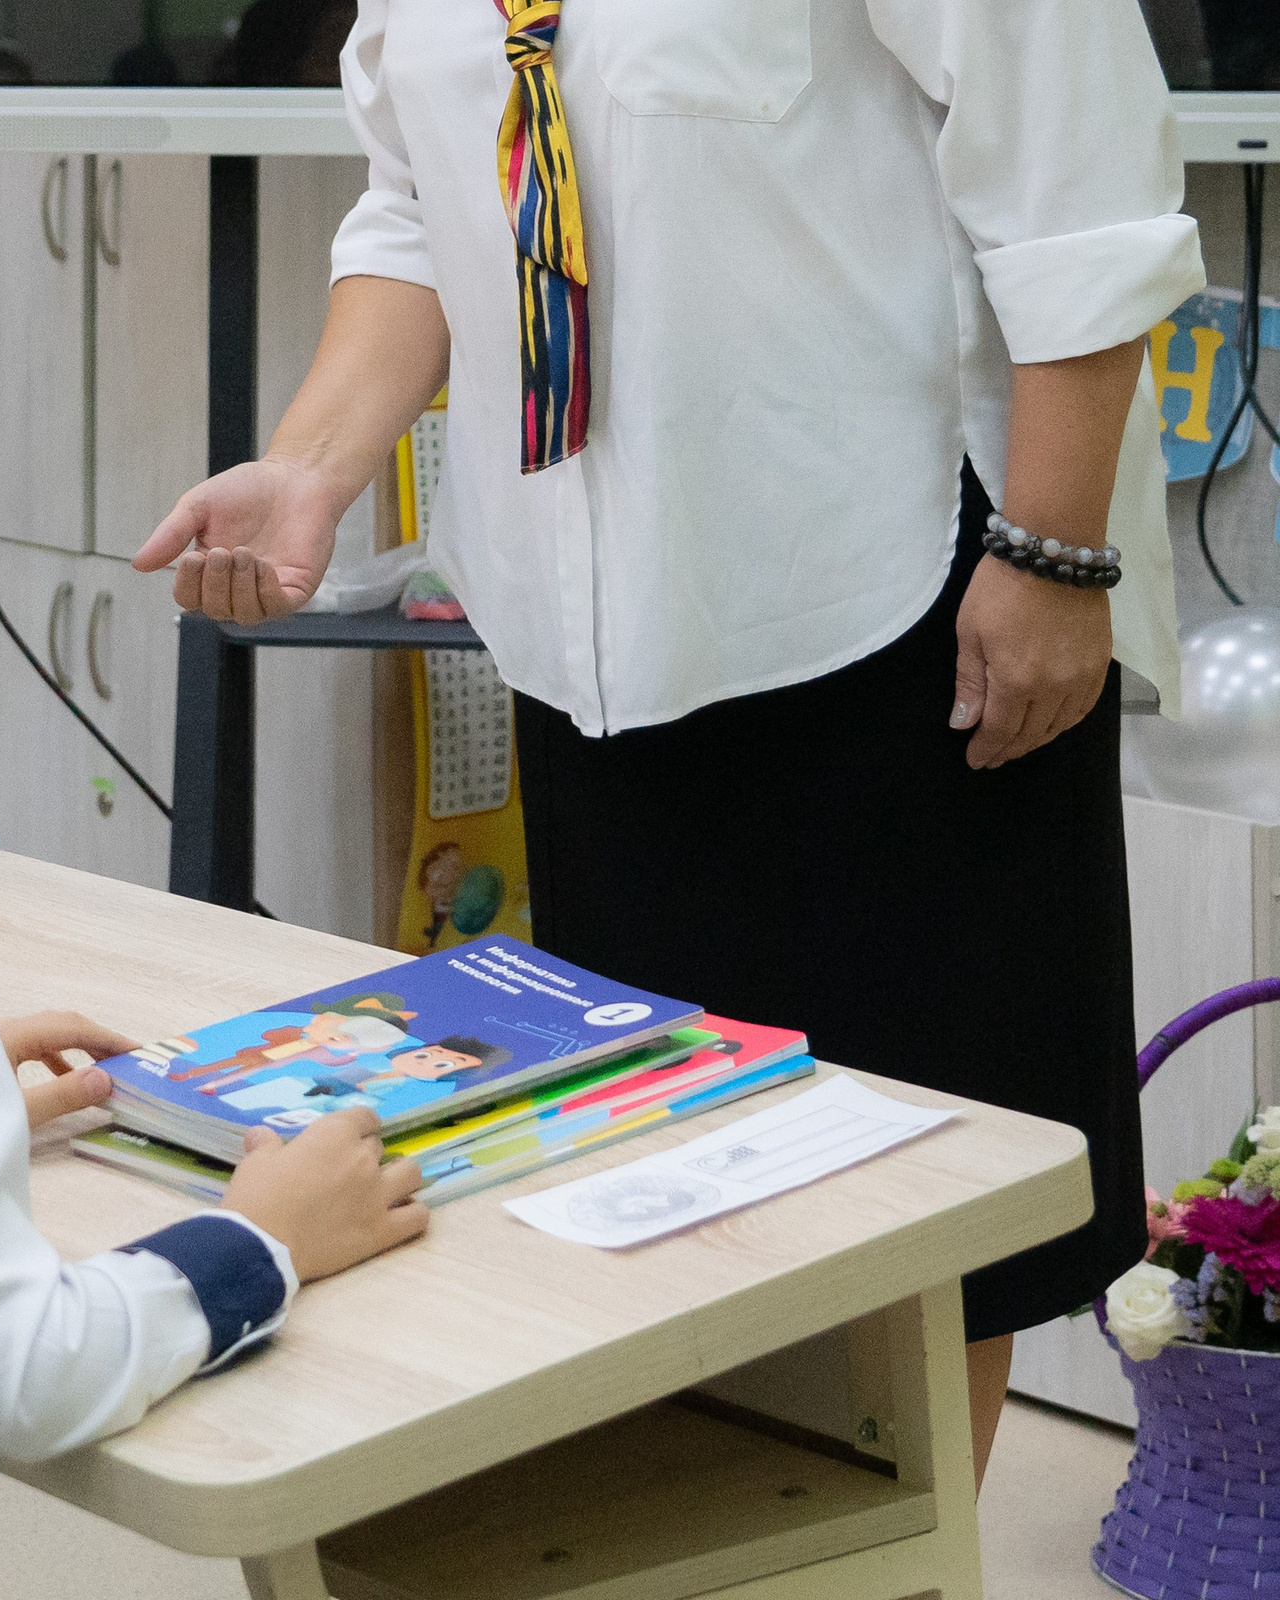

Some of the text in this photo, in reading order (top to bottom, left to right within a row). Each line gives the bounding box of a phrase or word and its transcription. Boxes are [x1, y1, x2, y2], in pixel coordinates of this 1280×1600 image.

[447, 958, 523, 995] технологии
[476, 957, 594, 1008] информационные
[485, 945, 577, 988] Информатика
[599, 1008, 634, 1020] 1
